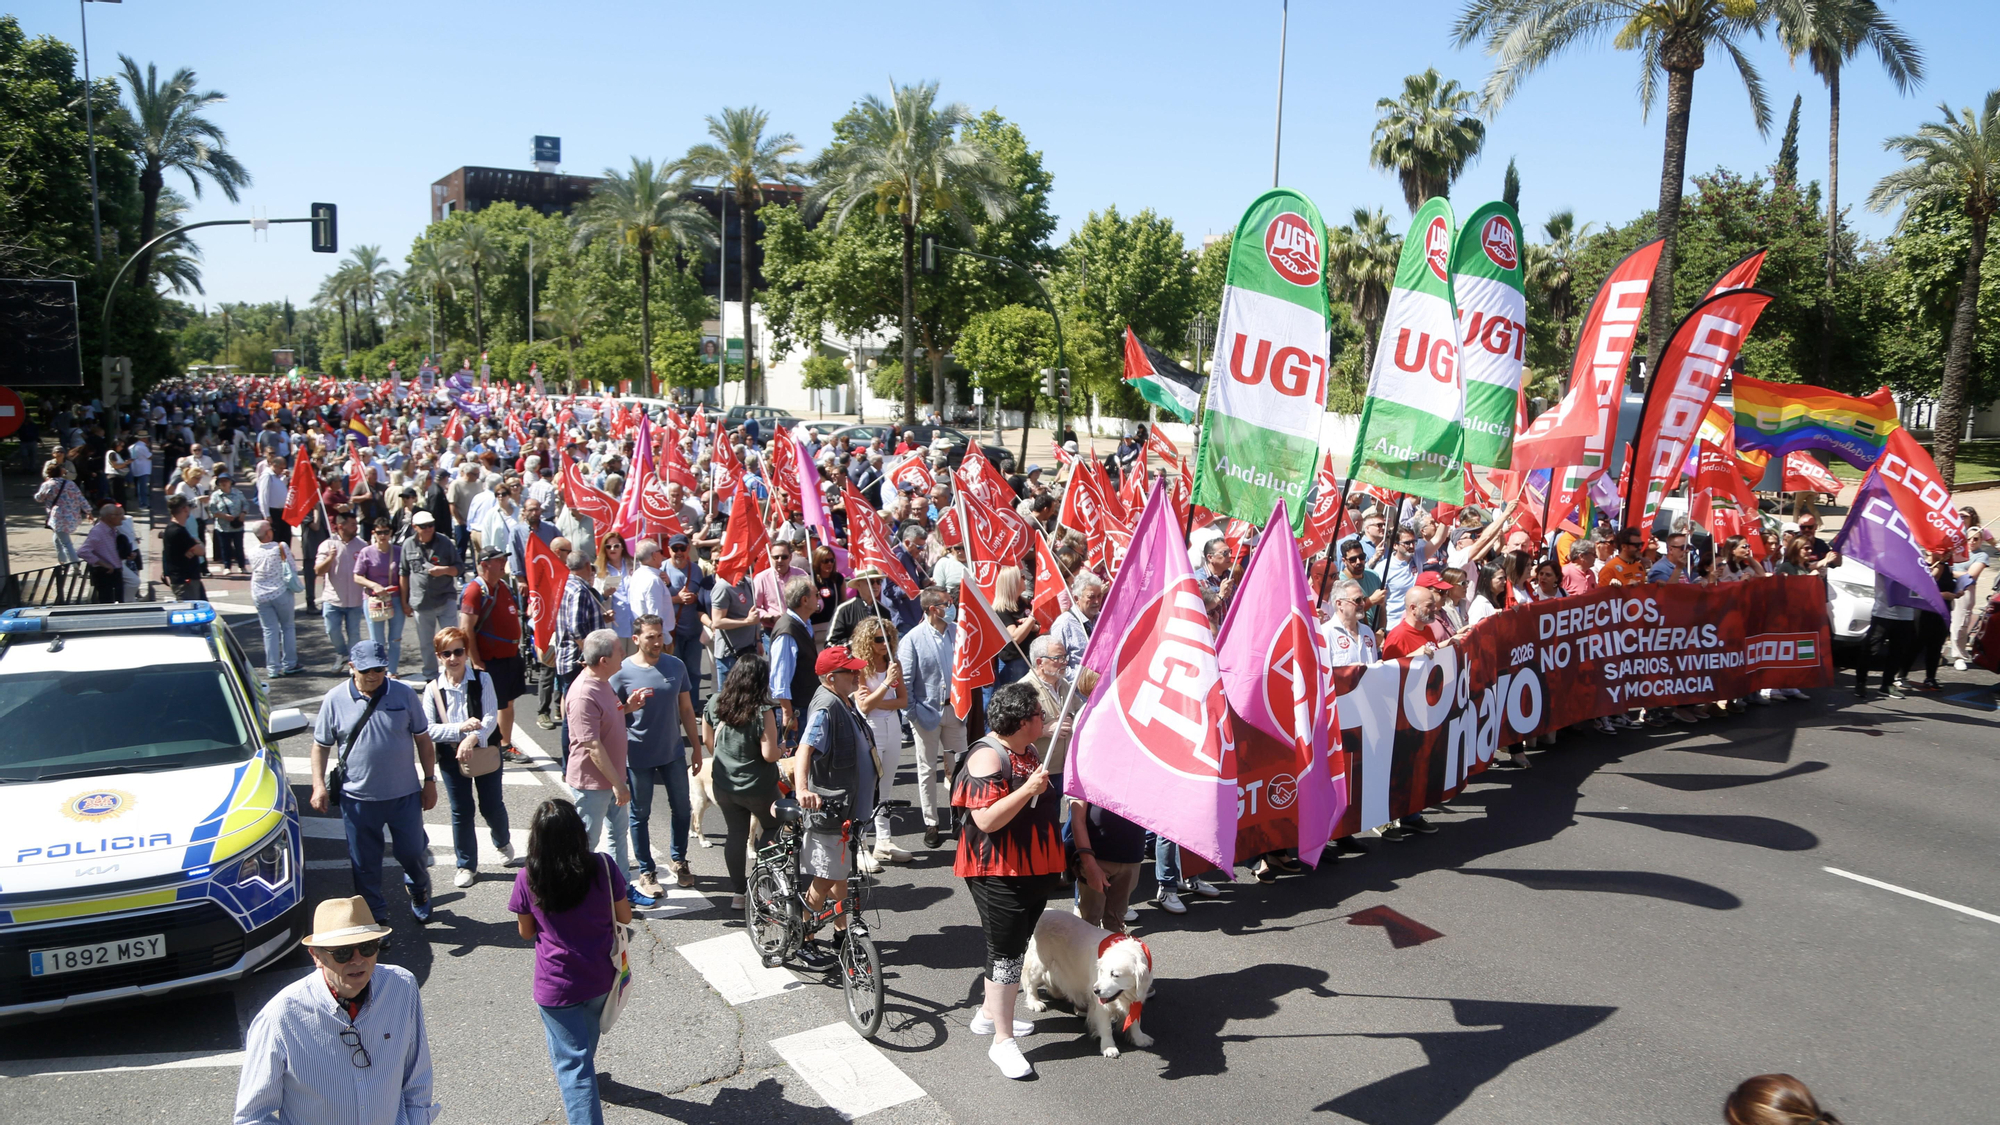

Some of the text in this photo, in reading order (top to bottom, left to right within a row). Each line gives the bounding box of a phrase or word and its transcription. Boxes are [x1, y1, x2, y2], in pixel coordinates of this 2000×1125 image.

[1273, 220, 1317, 262] UGT
[1431, 224, 1448, 249] UG
[1214, 455, 1308, 499] Andalucí
[1539, 598, 1665, 640] DERECHOS,
[1510, 642, 1534, 666] 2026
[1540, 641, 1571, 673] NO
[1676, 650, 1745, 672] VIVIENDA
[1605, 685, 1621, 703] Y
[52, 937, 160, 970] 1892 MSY
